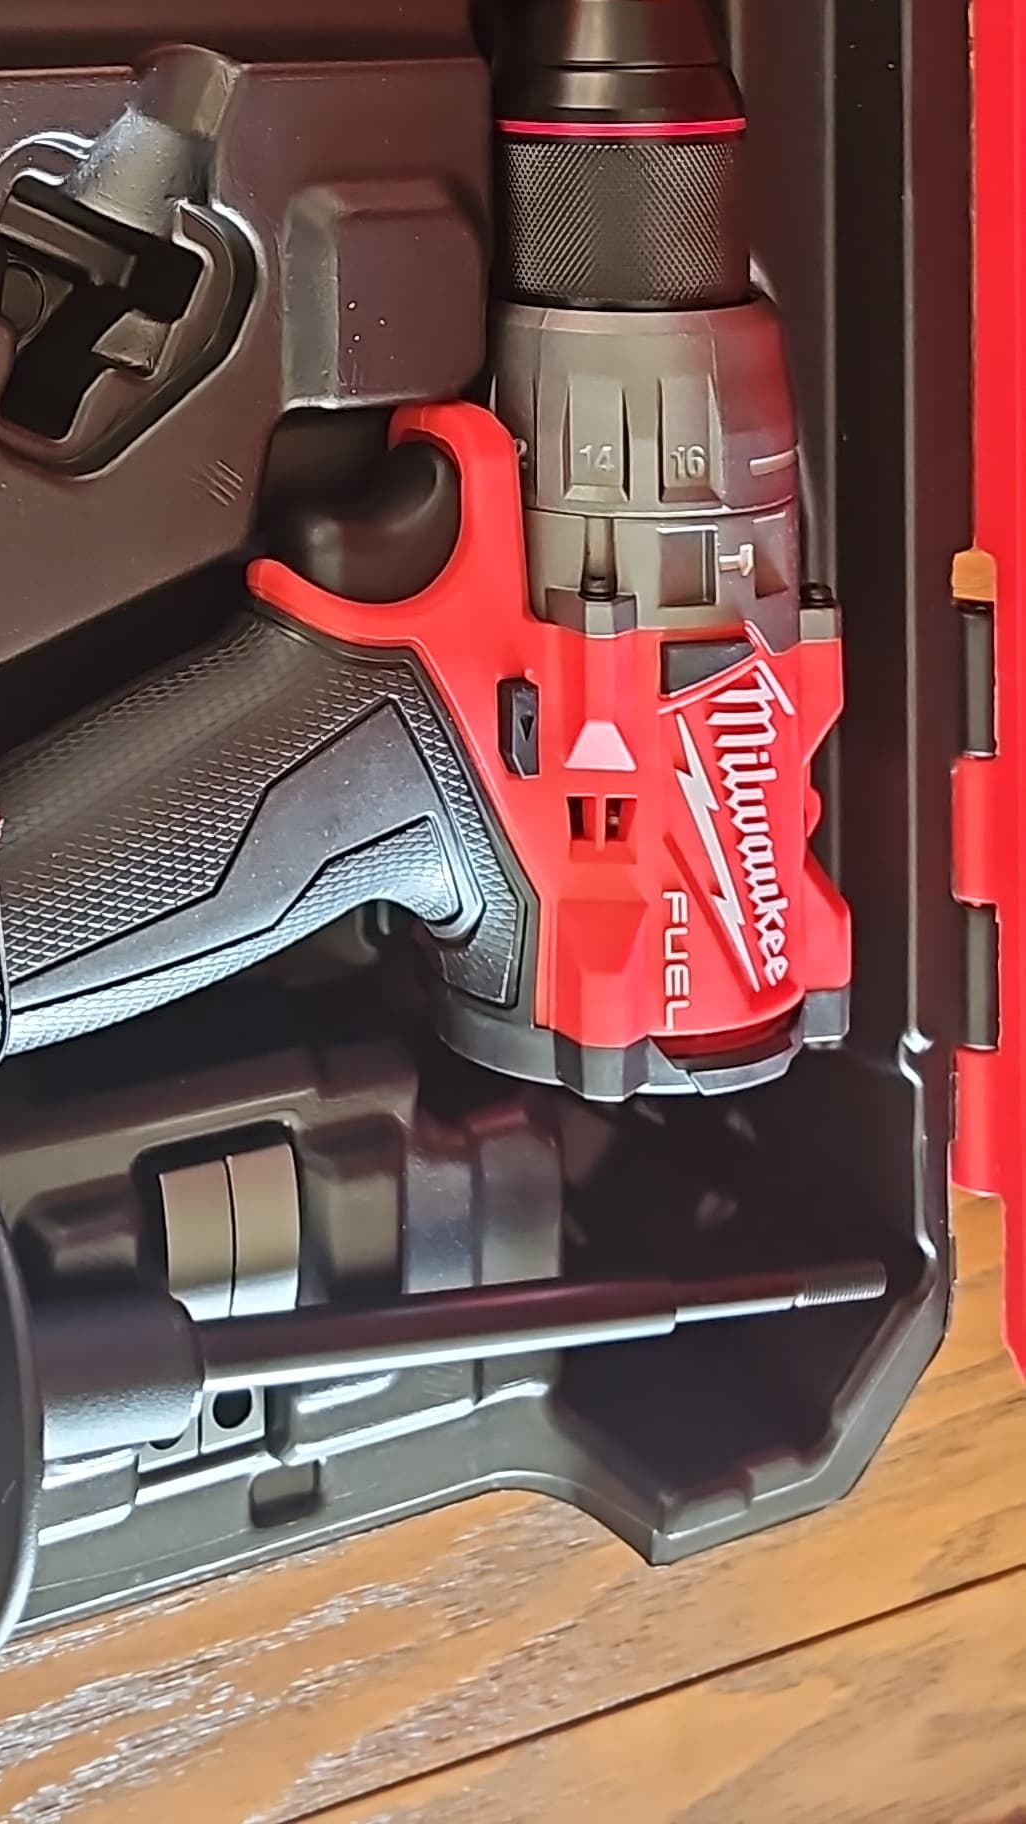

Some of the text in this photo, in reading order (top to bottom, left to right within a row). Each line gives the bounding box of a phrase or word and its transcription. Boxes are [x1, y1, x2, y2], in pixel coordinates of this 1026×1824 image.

[579, 444, 705, 478] 14 16
[705, 670, 789, 987] Milwaukee
[662, 889, 691, 1030] FUEL
